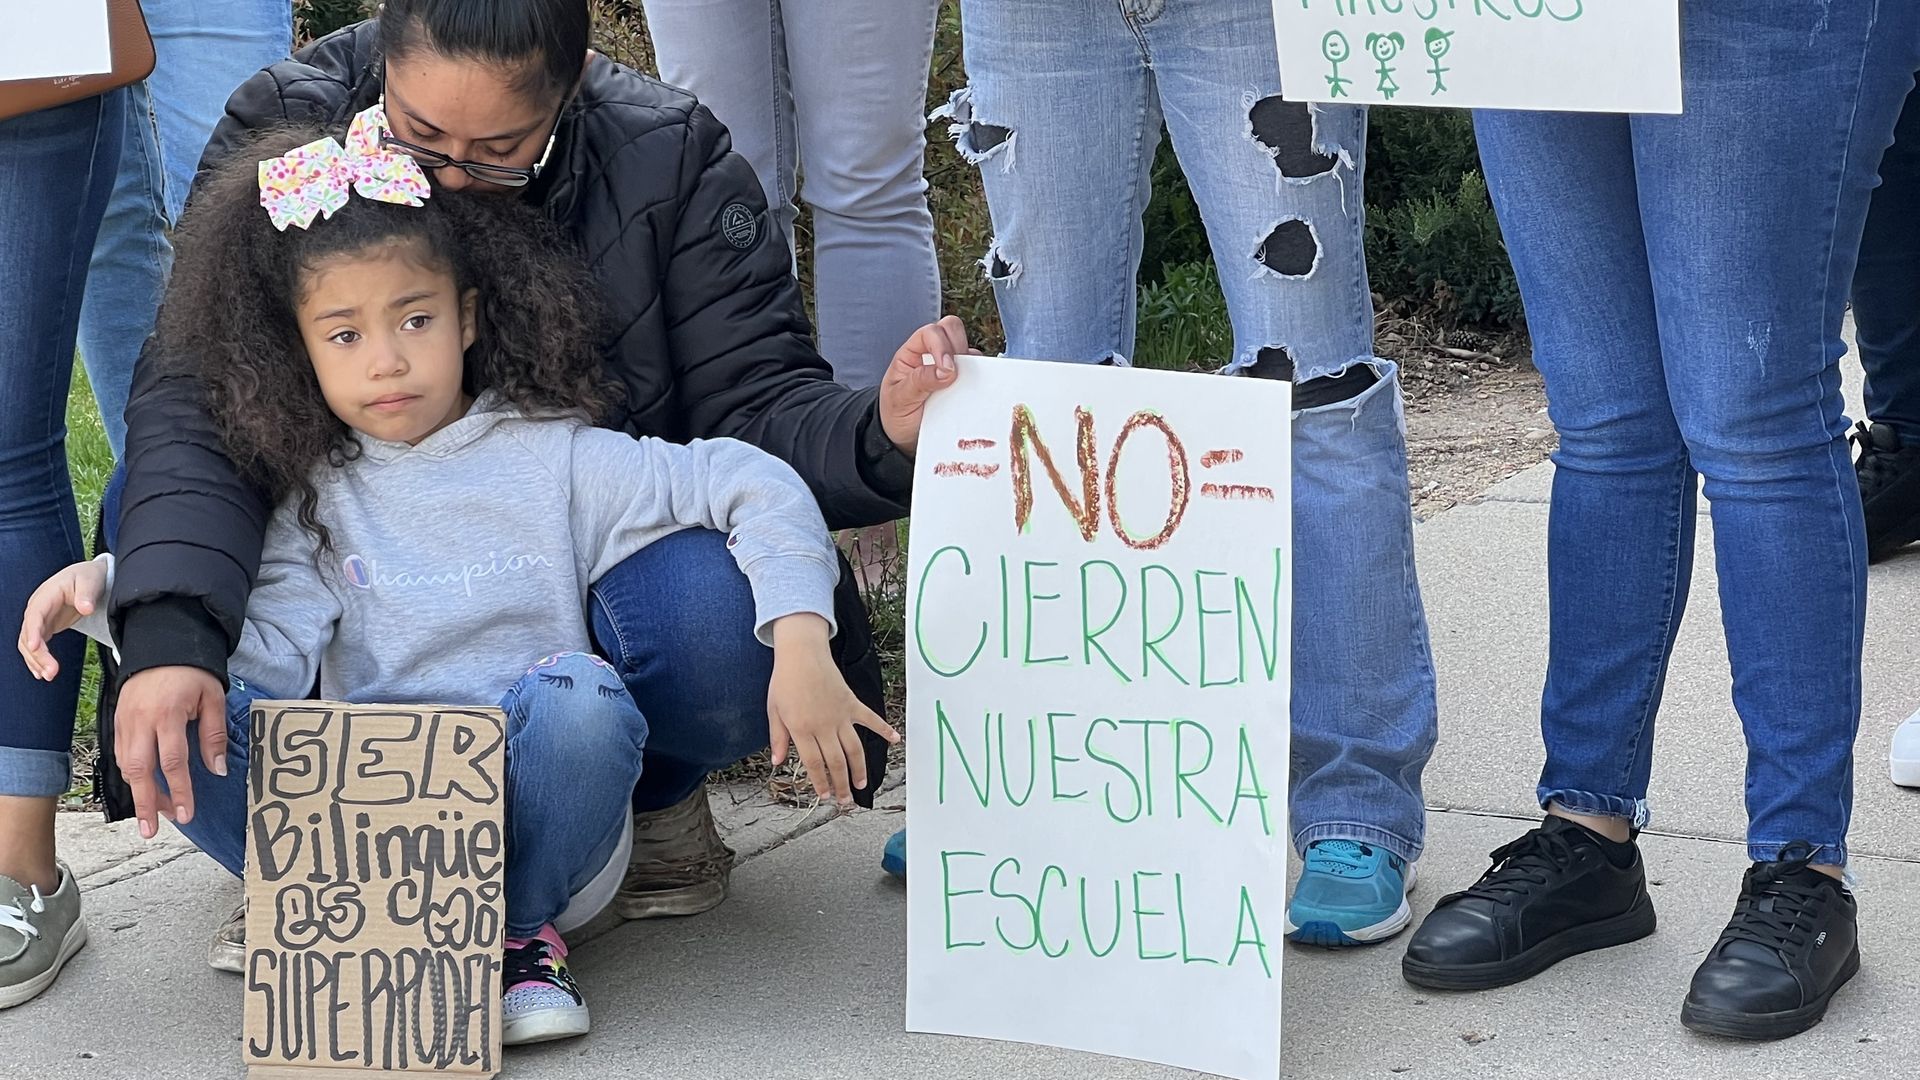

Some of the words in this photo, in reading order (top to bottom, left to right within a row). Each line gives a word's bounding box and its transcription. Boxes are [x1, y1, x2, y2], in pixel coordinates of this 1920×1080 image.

[343, 552, 553, 597] Champion
[915, 545, 1281, 687] CIERREN
[935, 699, 1272, 835] NUESTRA
[252, 800, 502, 925] Bilingüe
[940, 850, 1272, 979] ESCUELA
